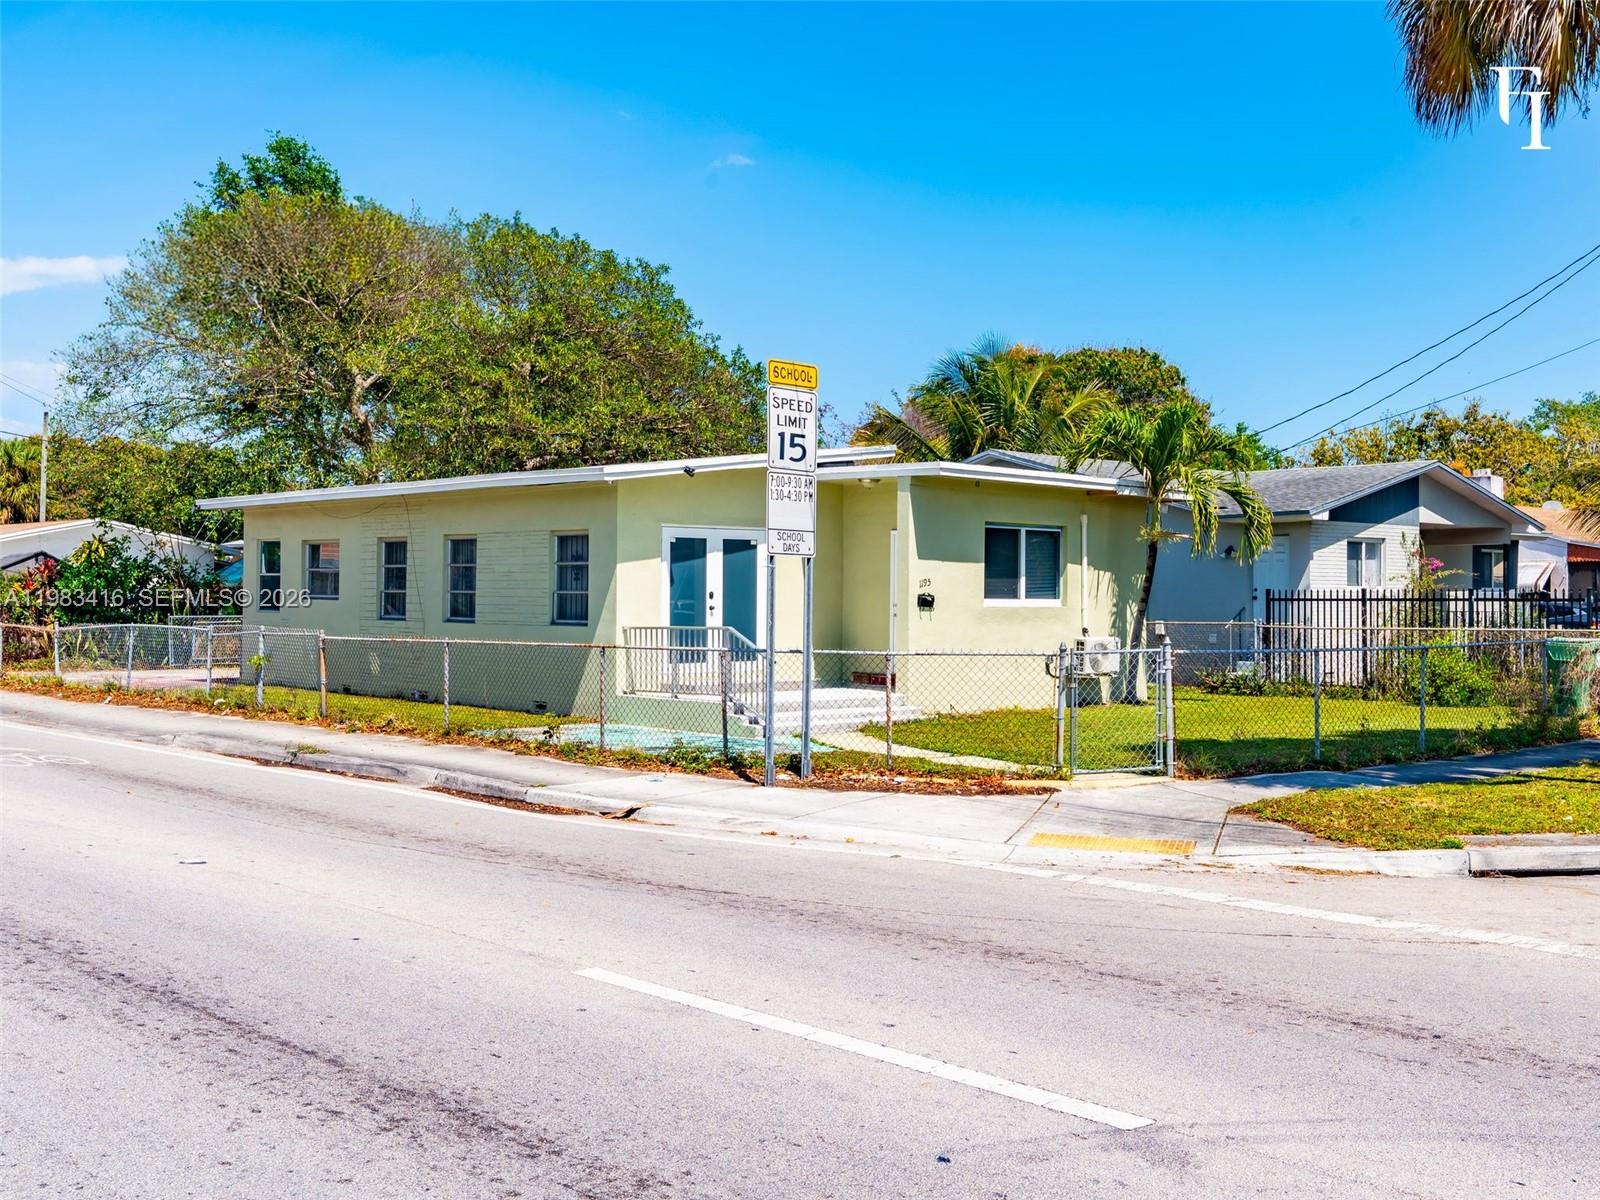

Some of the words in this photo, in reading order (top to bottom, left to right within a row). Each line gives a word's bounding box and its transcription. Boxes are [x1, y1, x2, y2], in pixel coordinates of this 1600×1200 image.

[773, 365, 812, 383] SCHOOL
[772, 396, 813, 413] SPEED
[776, 414, 808, 429] LIMIT
[777, 431, 807, 463] 15
[770, 474, 802, 489] 7:00-9:30
[803, 477, 814, 490] AM
[770, 488, 802, 503] 1:30-4:30
[803, 490, 814, 503] PM
[776, 531, 806, 543] SCHOOL
[782, 542, 801, 553] DAYS
